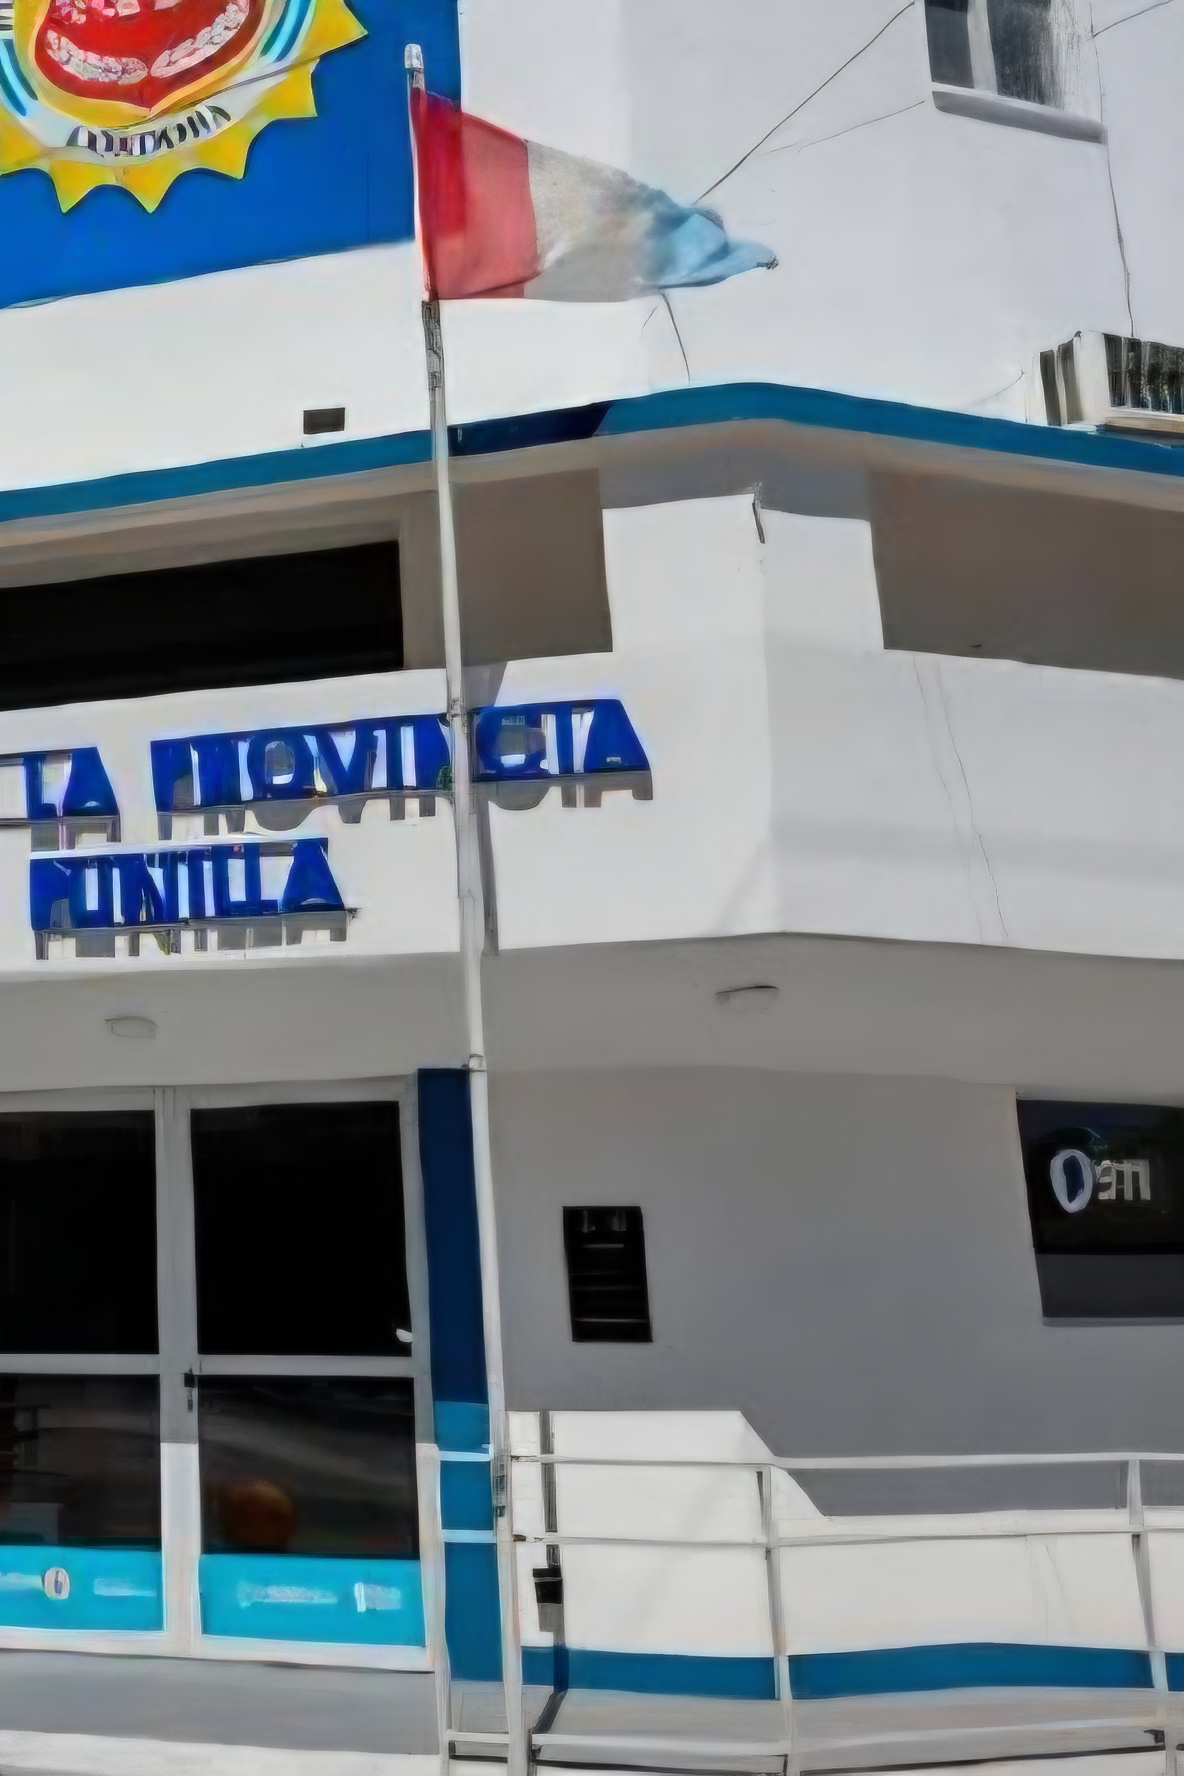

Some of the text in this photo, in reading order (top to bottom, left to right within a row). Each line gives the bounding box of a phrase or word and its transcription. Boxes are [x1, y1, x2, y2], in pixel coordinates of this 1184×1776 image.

[23, 747, 119, 819] LA
[150, 699, 651, 813] PROVINCIA
[30, 838, 347, 930] PUNILLA
